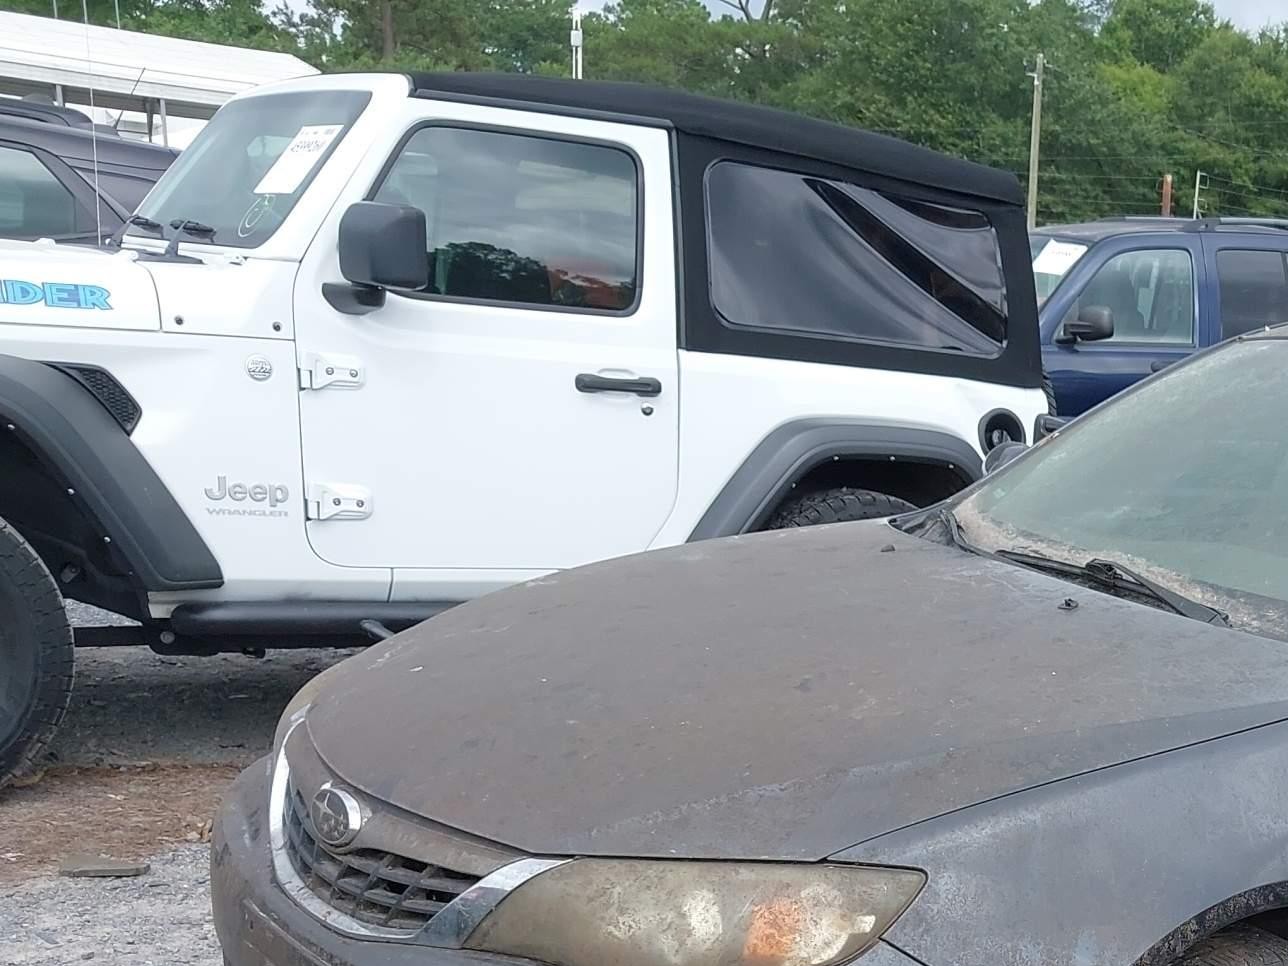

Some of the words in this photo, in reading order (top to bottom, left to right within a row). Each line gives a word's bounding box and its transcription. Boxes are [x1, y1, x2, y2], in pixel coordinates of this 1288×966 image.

[0, 280, 113, 310] DER
[204, 475, 289, 507] Jeep
[206, 508, 289, 517] WRANGLER
